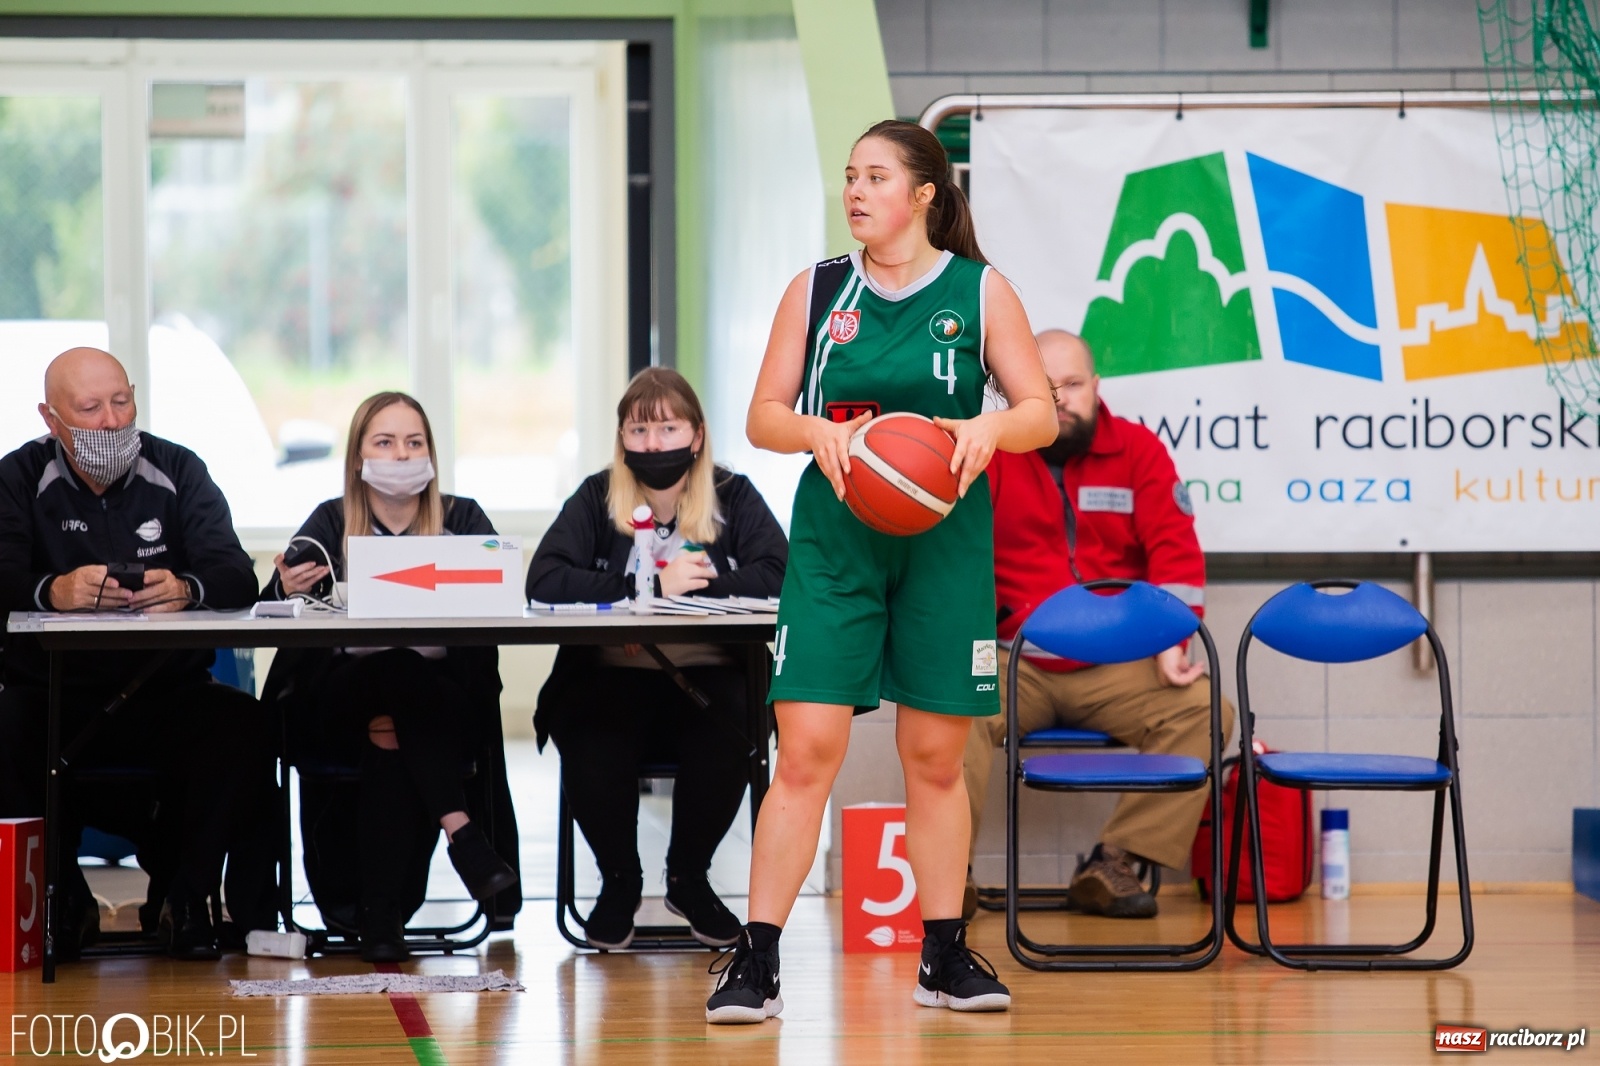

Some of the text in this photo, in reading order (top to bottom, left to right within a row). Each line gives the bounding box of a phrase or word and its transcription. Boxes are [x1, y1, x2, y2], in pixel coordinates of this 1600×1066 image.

[933, 349, 958, 394] 4
[1114, 398, 1269, 450] wiat
[1185, 468, 1600, 502] na oaza kultur
[773, 624, 788, 676] 4
[19, 835, 39, 932] 5
[861, 821, 917, 916] 5
